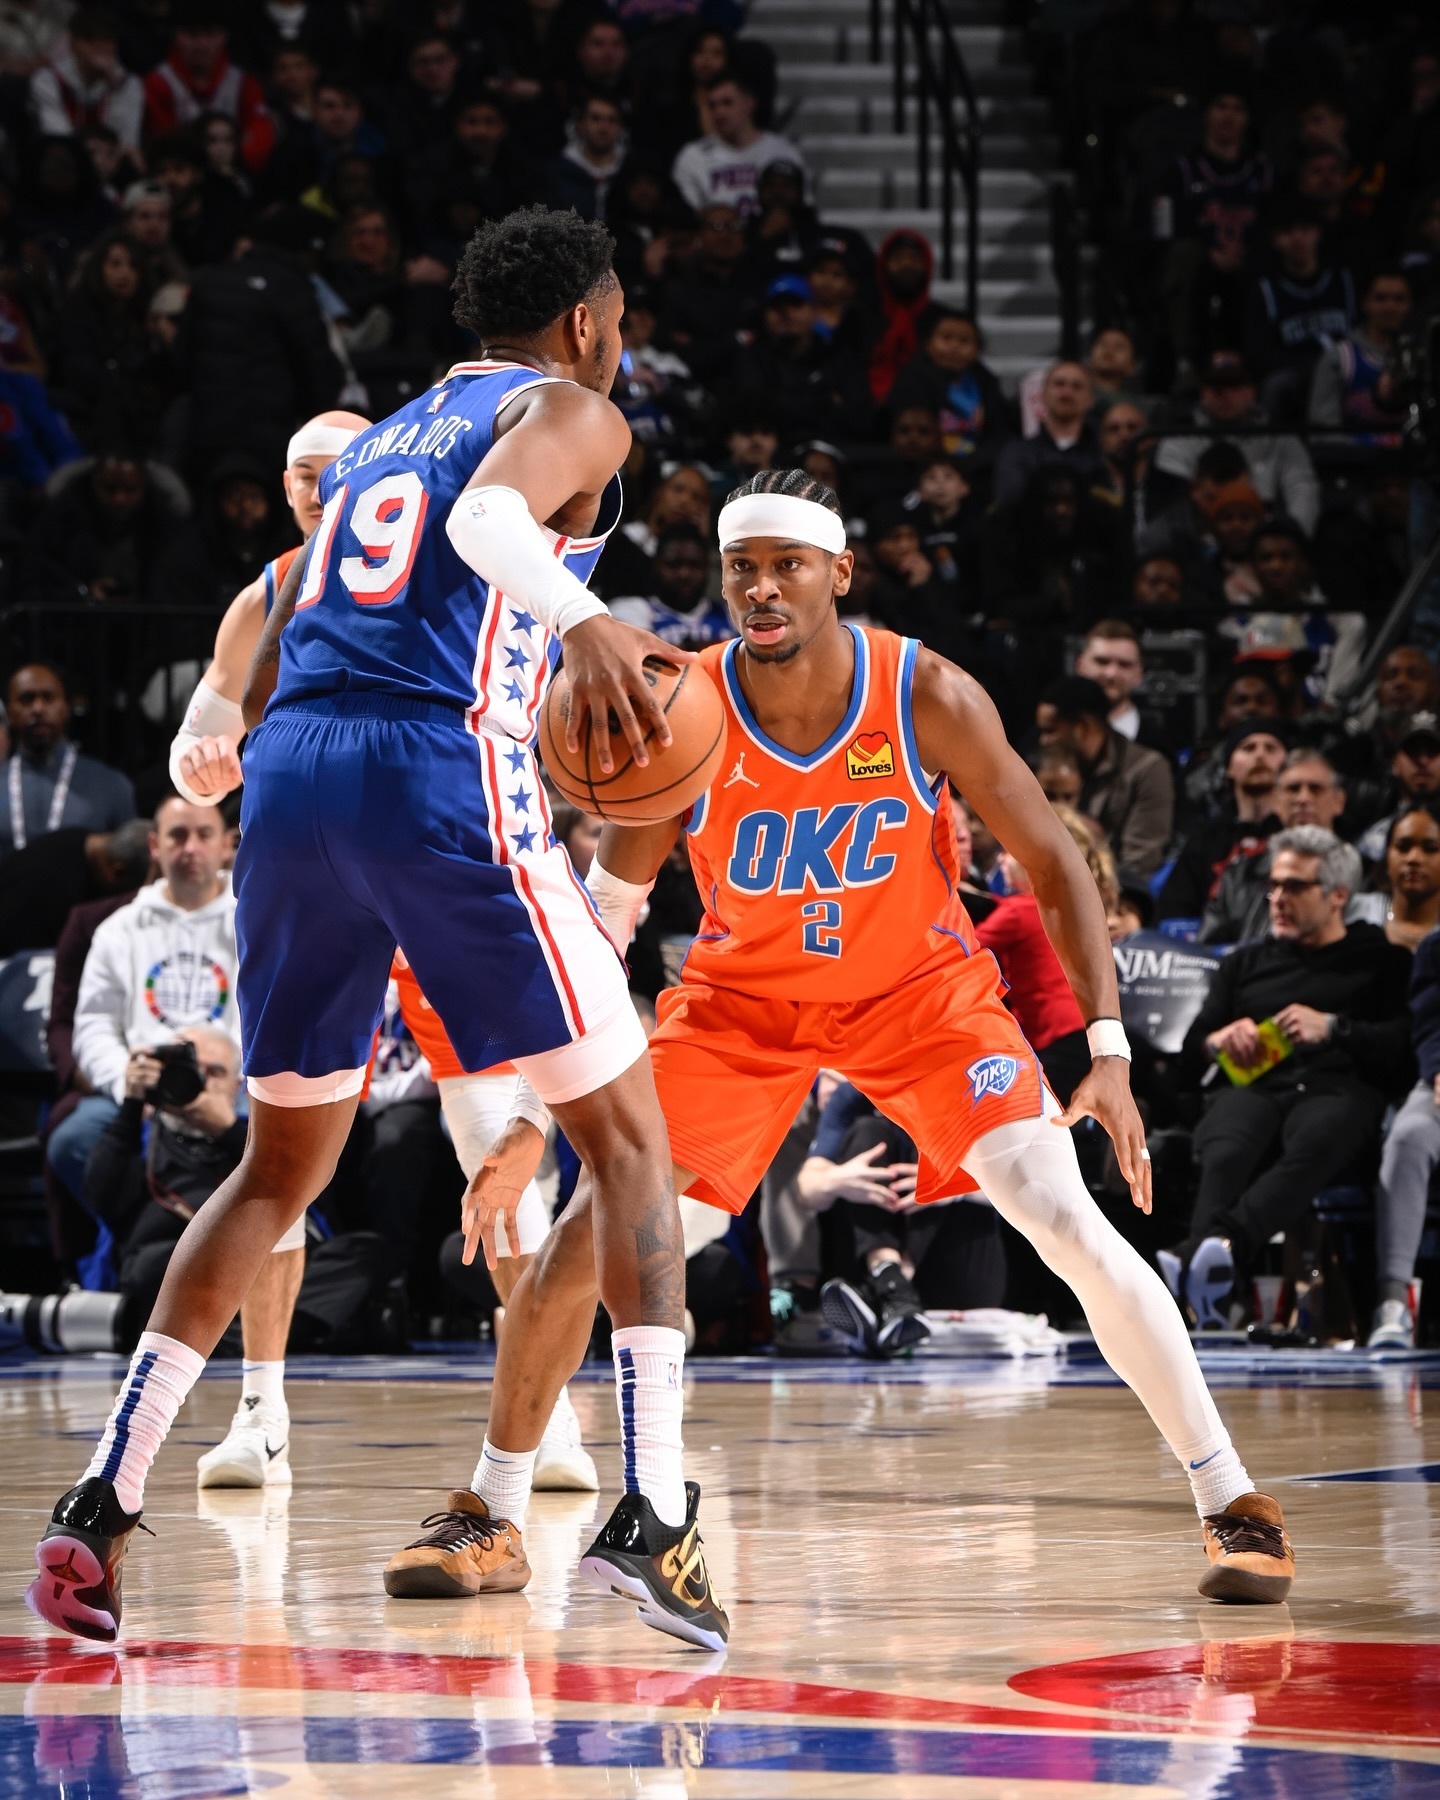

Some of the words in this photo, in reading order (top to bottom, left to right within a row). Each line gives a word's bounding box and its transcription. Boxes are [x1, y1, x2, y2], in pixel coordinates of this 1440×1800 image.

[333, 415, 473, 483] EDWARDS
[295, 471, 430, 612] 19
[726, 796, 909, 897] OKC
[801, 900, 842, 960] 2
[974, 1057, 1008, 1098] OKC
